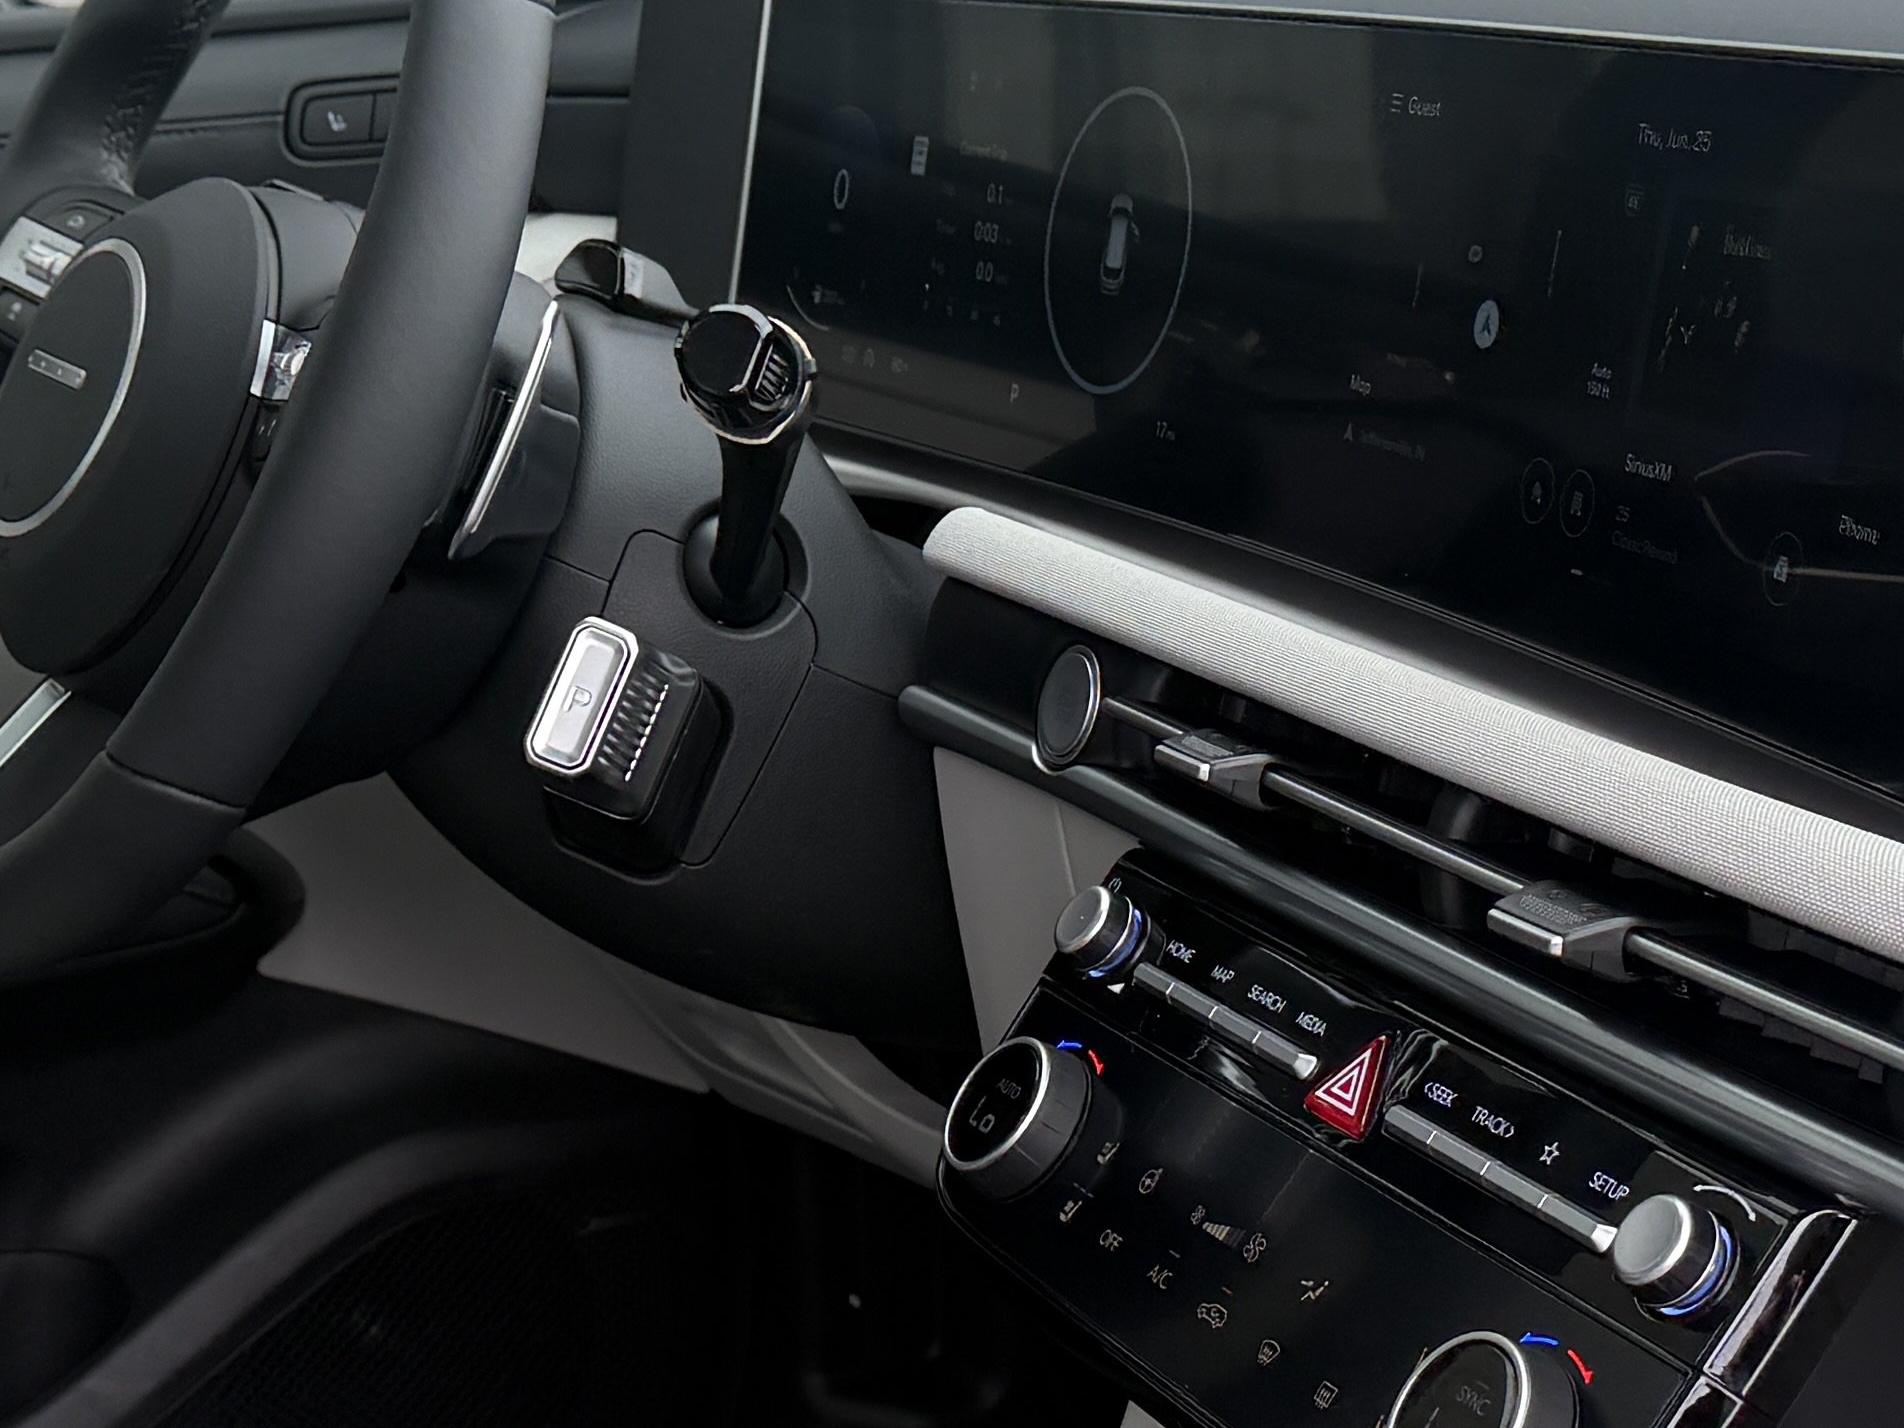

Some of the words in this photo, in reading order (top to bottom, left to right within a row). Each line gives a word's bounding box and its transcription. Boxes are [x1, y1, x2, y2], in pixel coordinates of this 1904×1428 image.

[833, 168, 850, 210] 0
[1009, 382, 1020, 403] P
[1624, 452, 1673, 483] SiriusXM
[562, 684, 593, 713] P
[1166, 939, 1197, 964] HOME
[1210, 964, 1235, 983] MAP
[1247, 984, 1287, 1014] SEARCH
[1295, 1011, 1327, 1037] MEDIA
[996, 1077, 1022, 1100] AUTO
[1588, 1171, 1630, 1202] SETUP
[1099, 1228, 1124, 1252] OFF
[1146, 1264, 1174, 1290] A/C
[1455, 1385, 1492, 1417] SYNC
